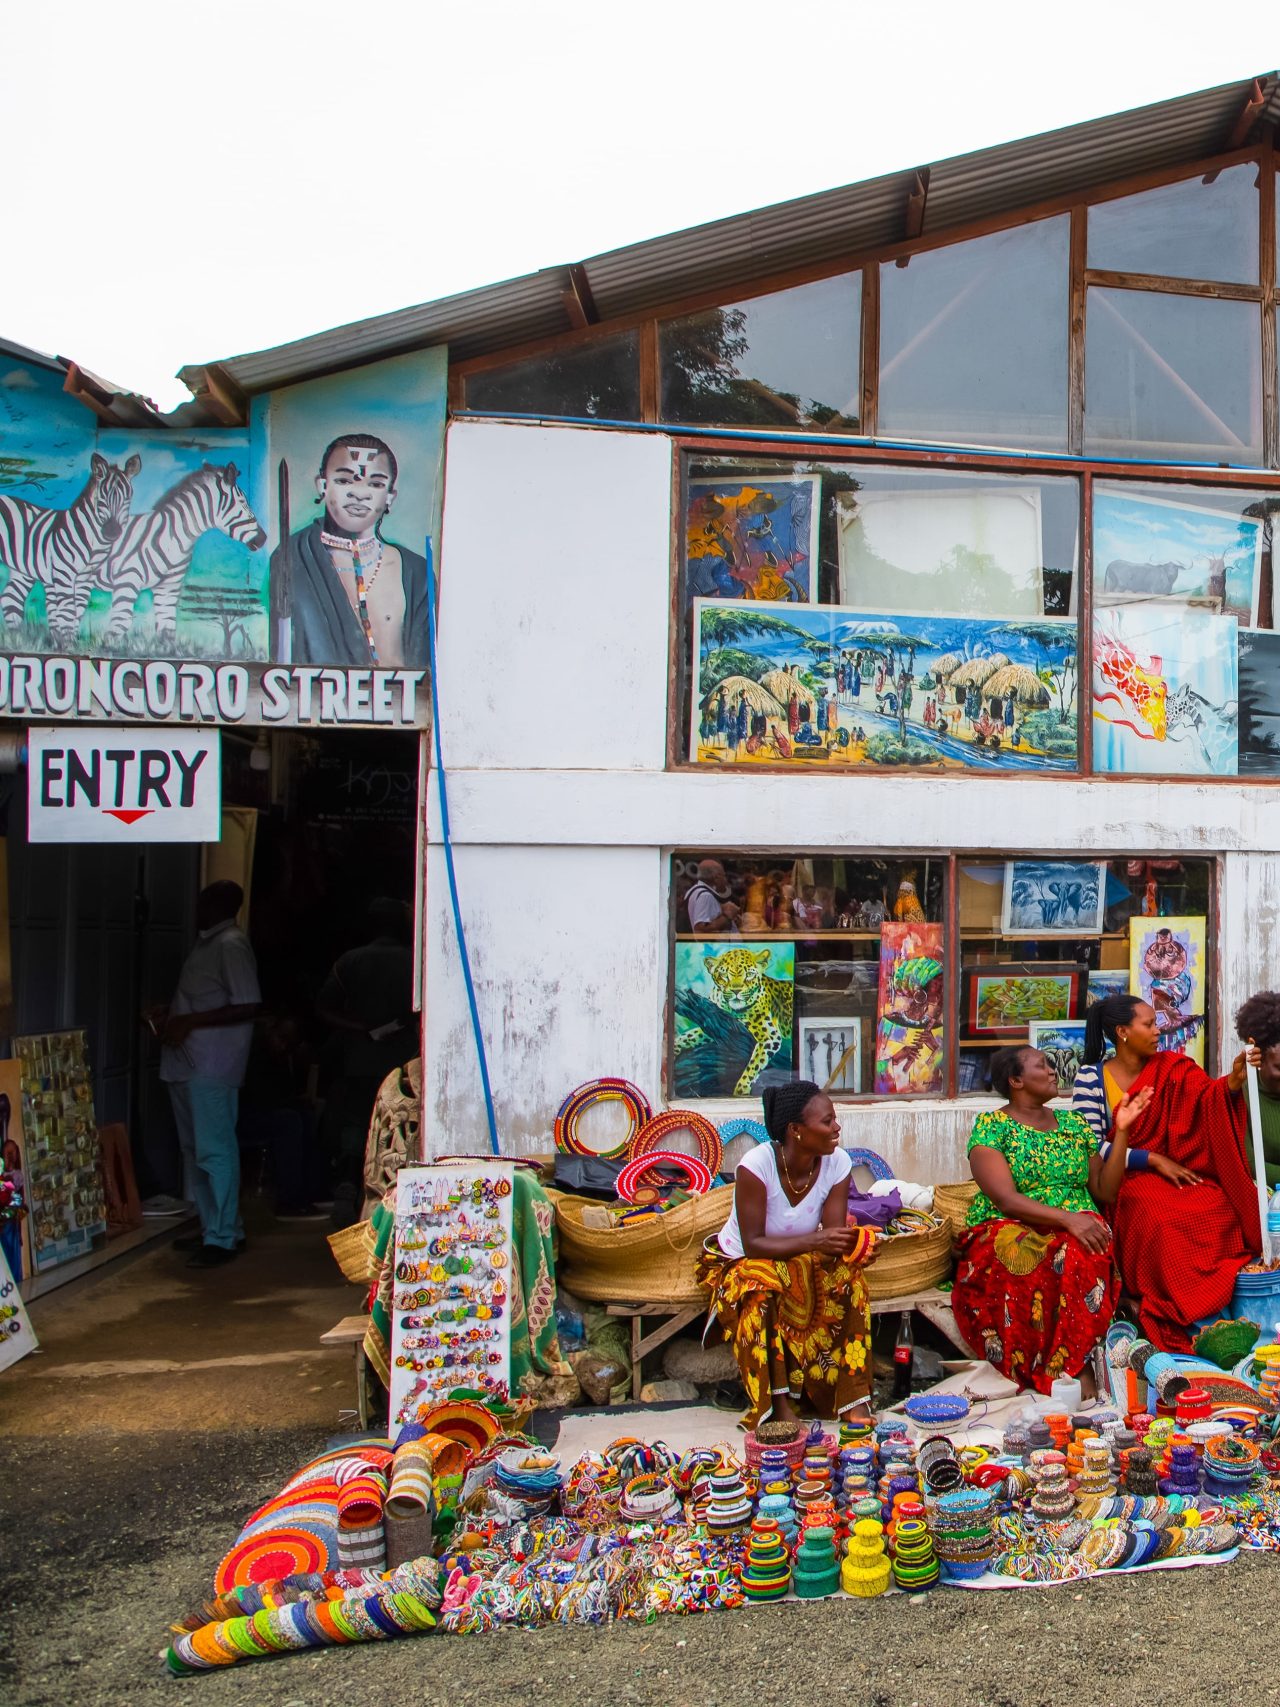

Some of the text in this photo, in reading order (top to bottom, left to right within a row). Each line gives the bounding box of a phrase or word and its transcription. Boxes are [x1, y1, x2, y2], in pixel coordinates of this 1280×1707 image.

[0, 656, 426, 724] RONGORO STREET
[41, 749, 208, 808] ENTRY
